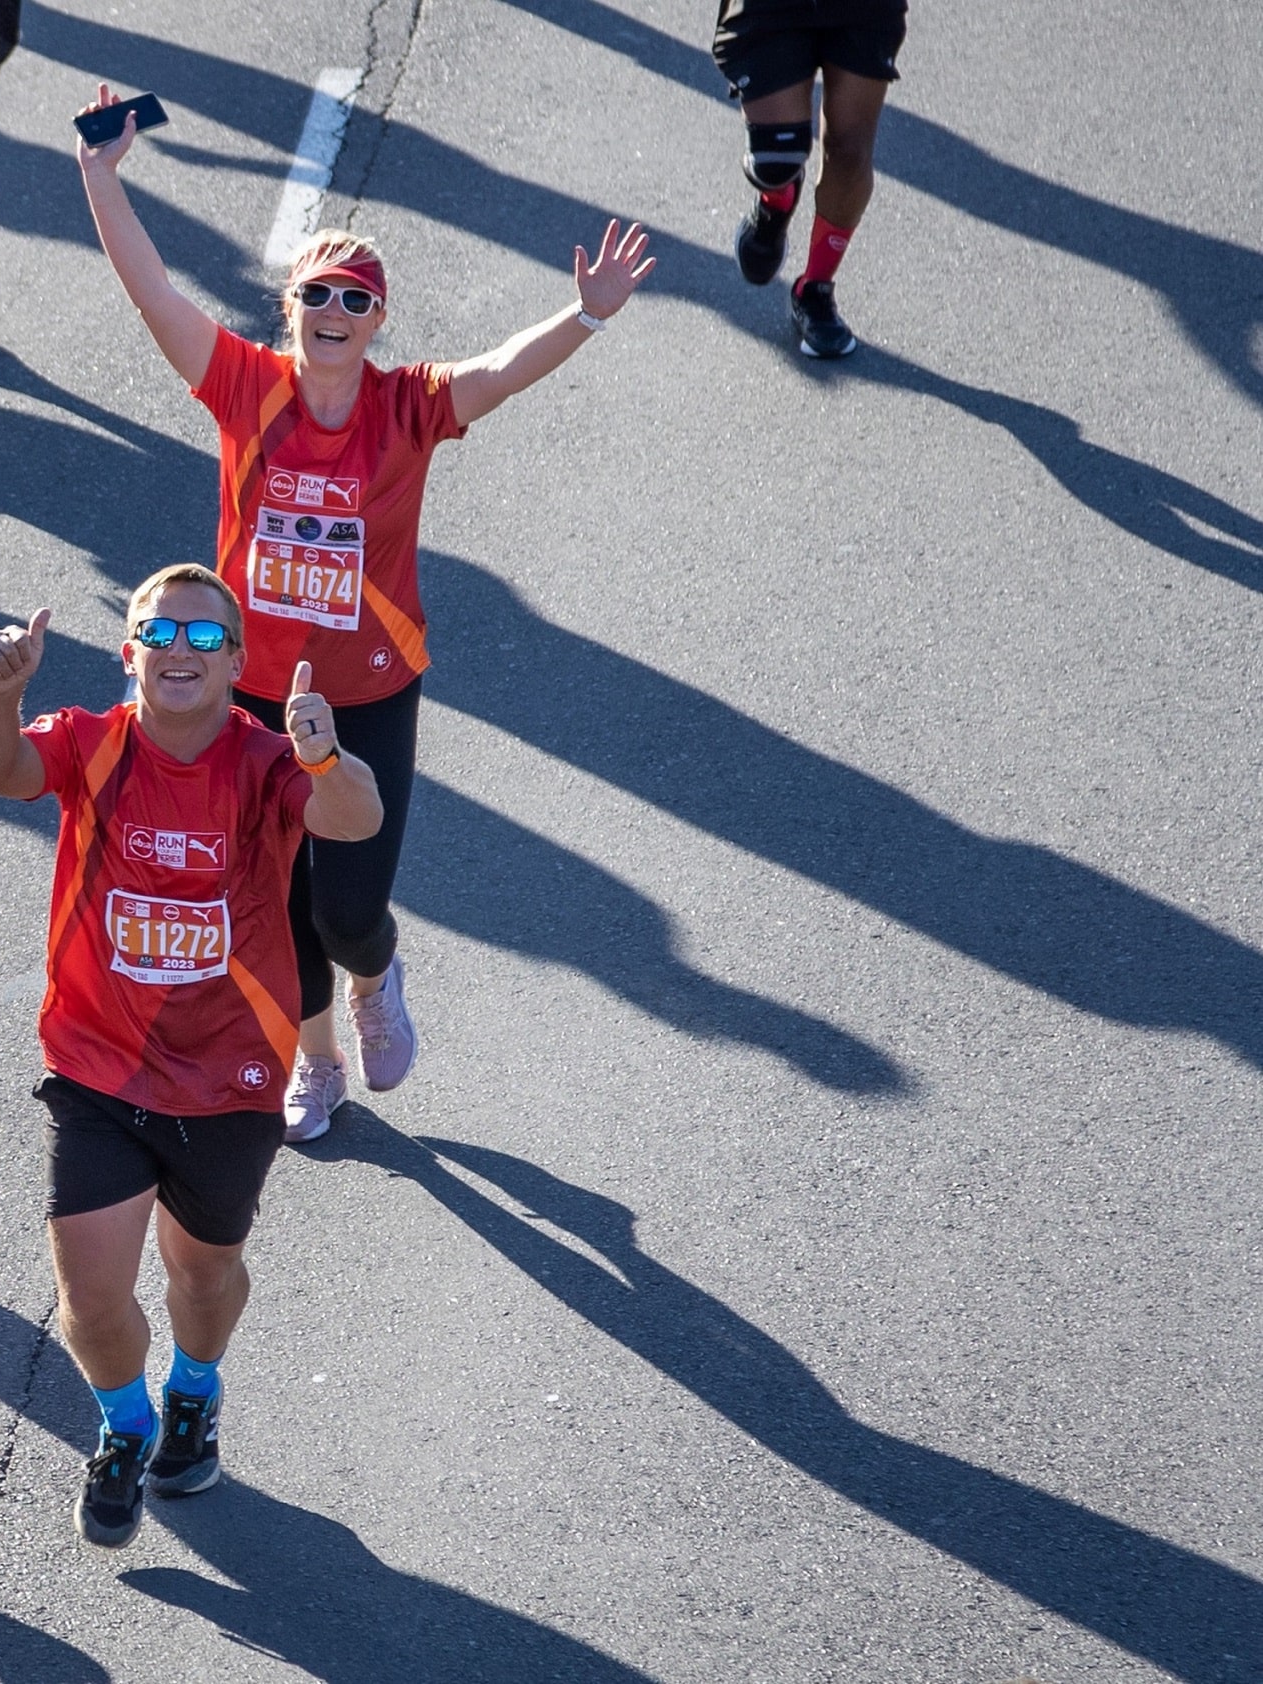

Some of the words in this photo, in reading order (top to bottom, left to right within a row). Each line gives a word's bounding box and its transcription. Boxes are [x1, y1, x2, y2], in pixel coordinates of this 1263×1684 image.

[299, 478, 324, 490] RUN
[267, 516, 284, 526] WPA
[331, 524, 357, 535] ASA
[260, 559, 274, 590] E
[280, 562, 353, 603] 11674
[300, 598, 329, 612] 2023
[157, 835, 184, 849] RUN
[117, 916, 130, 953] E
[138, 920, 219, 959] 11272
[162, 958, 195, 969] 2023
